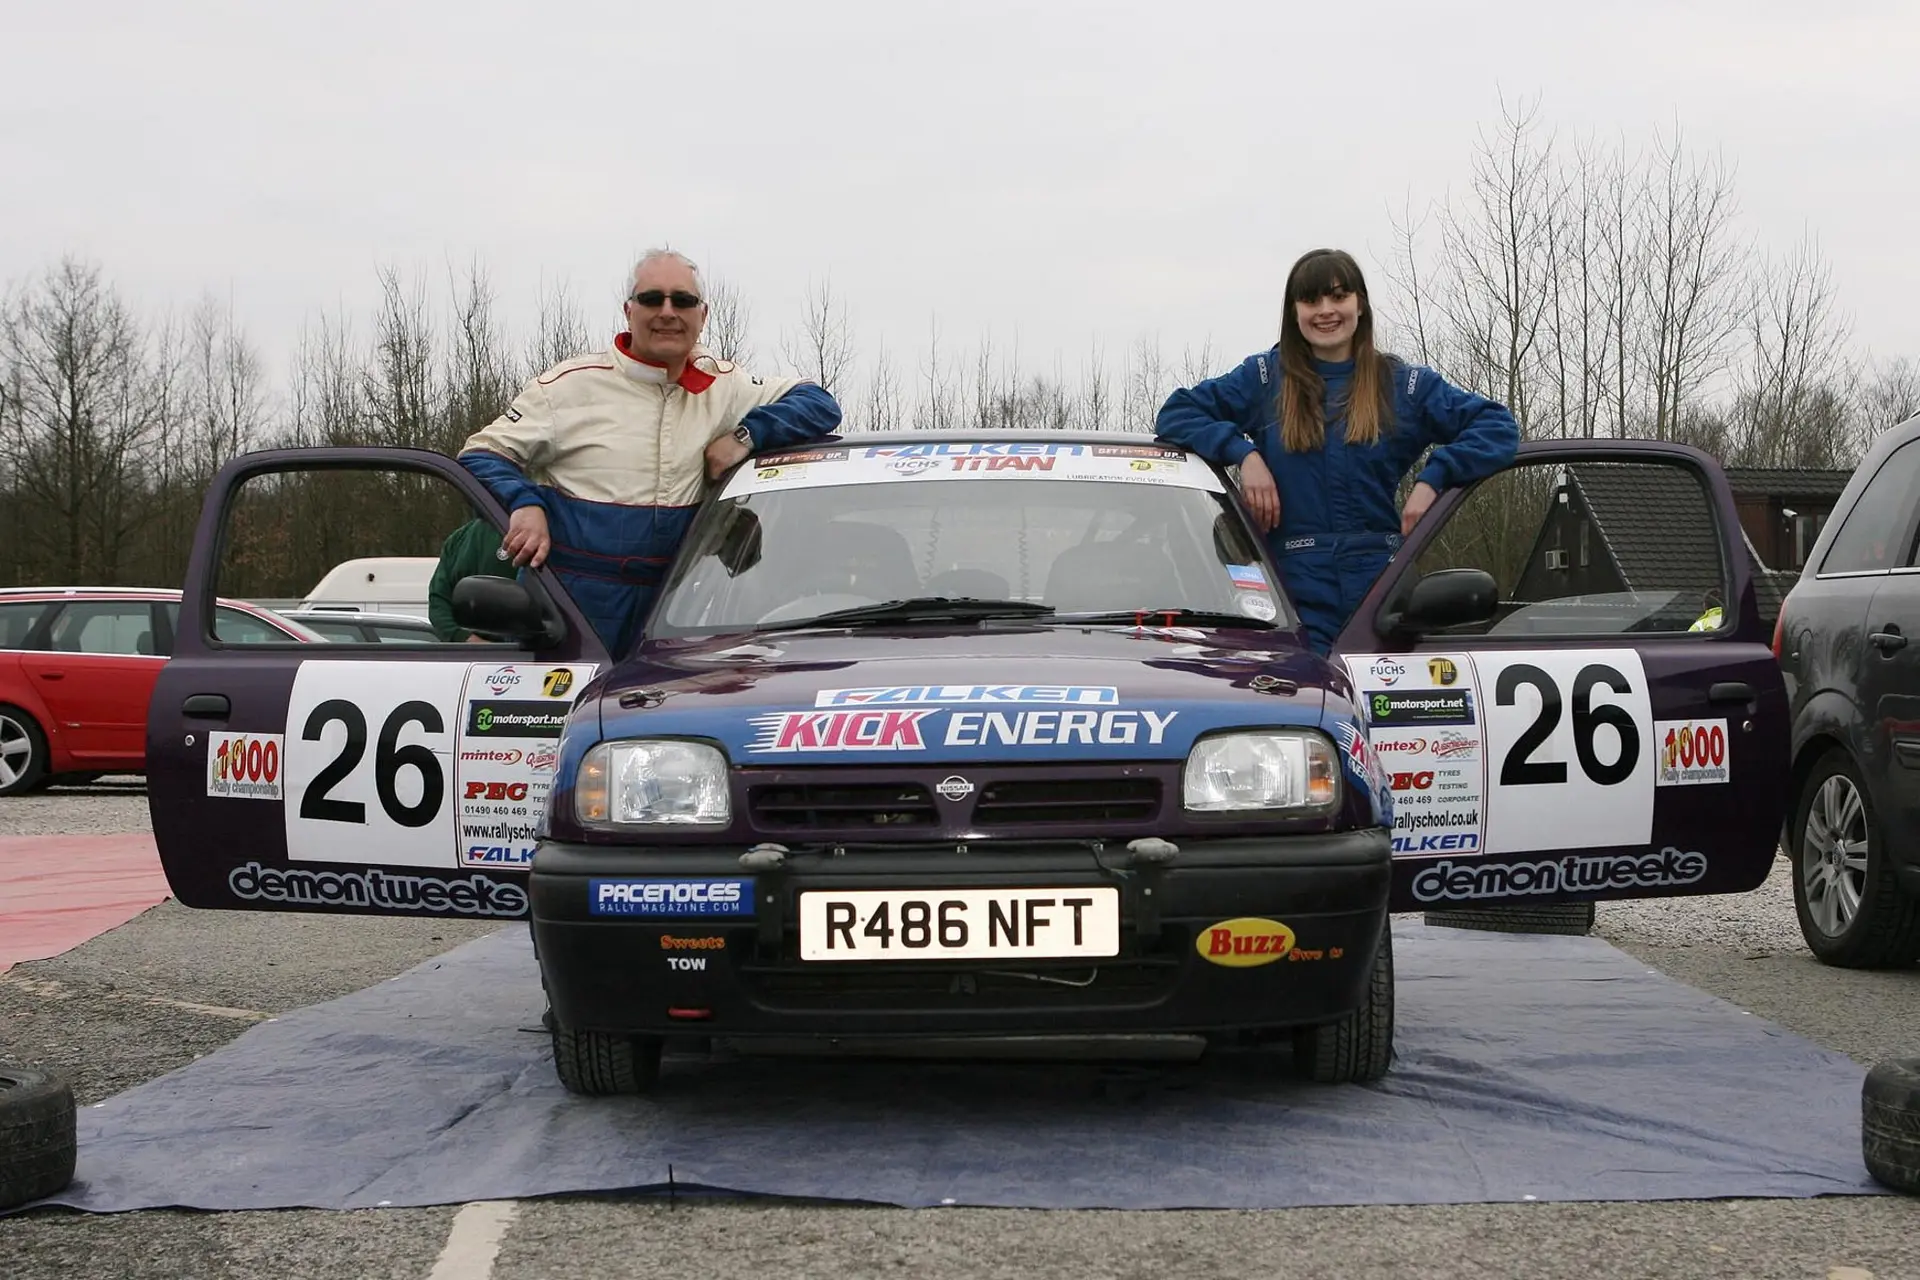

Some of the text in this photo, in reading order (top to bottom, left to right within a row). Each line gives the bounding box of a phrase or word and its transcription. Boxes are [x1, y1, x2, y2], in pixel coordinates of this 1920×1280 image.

[864, 443, 1084, 459] FALKEN
[1370, 665, 1406, 675] FUCHS
[485, 675, 521, 685] FUCHS
[830, 686, 1115, 705] FALKEN
[776, 709, 1179, 749] KICK ENERGY
[1496, 663, 1641, 786] 26
[460, 749, 514, 761] mintex
[1665, 725, 1725, 769] 1000
[217, 739, 279, 783] 1000
[299, 698, 445, 828] 26
[1438, 769, 1461, 778] TYRES
[463, 782, 529, 801] PEC
[1438, 782, 1469, 791] TESTING
[1398, 796, 1414, 805] 460
[1416, 795, 1432, 805] 469
[1437, 795, 1480, 804] CORPORATE
[465, 805, 491, 815] 01490
[493, 806, 509, 816] 460
[511, 807, 528, 816] 469
[463, 821, 537, 844] www.rallyscho
[1391, 833, 1479, 853] ALKEN
[468, 845, 538, 863] FALK
[1413, 848, 1706, 899] demon tweeks
[230, 863, 528, 915] demon tweeks
[598, 882, 742, 903] PACENOTES
[599, 902, 740, 913] RALLY MAGAZINE.COM
[825, 898, 1093, 949] R486 NFT
[660, 934, 726, 950] Sweets
[1208, 928, 1287, 956] Buzz
[667, 957, 707, 971] TOW
